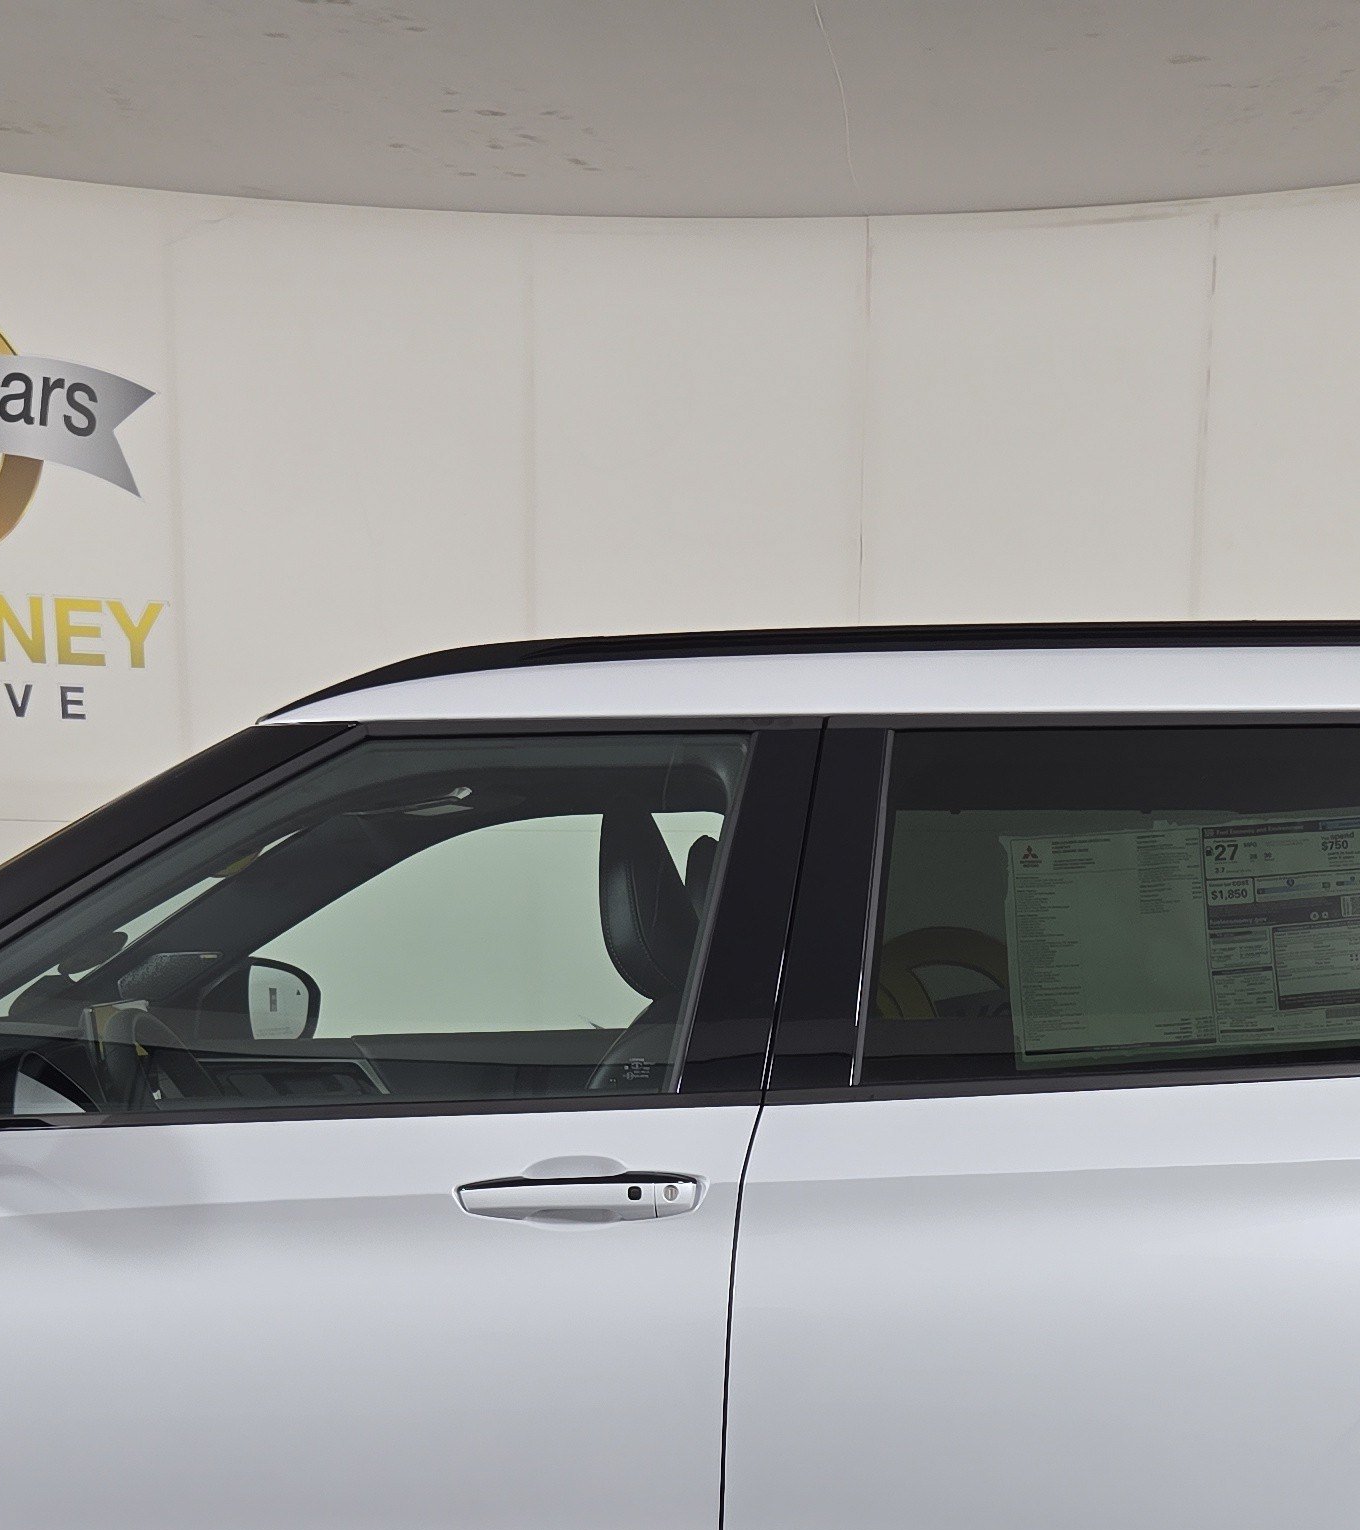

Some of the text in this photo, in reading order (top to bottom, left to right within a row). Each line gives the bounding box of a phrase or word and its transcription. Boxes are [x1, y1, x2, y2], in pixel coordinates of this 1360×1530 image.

[1214, 843, 1239, 861] 27
[1321, 840, 1349, 851] $750
[1210, 887, 1248, 901] $1,850
